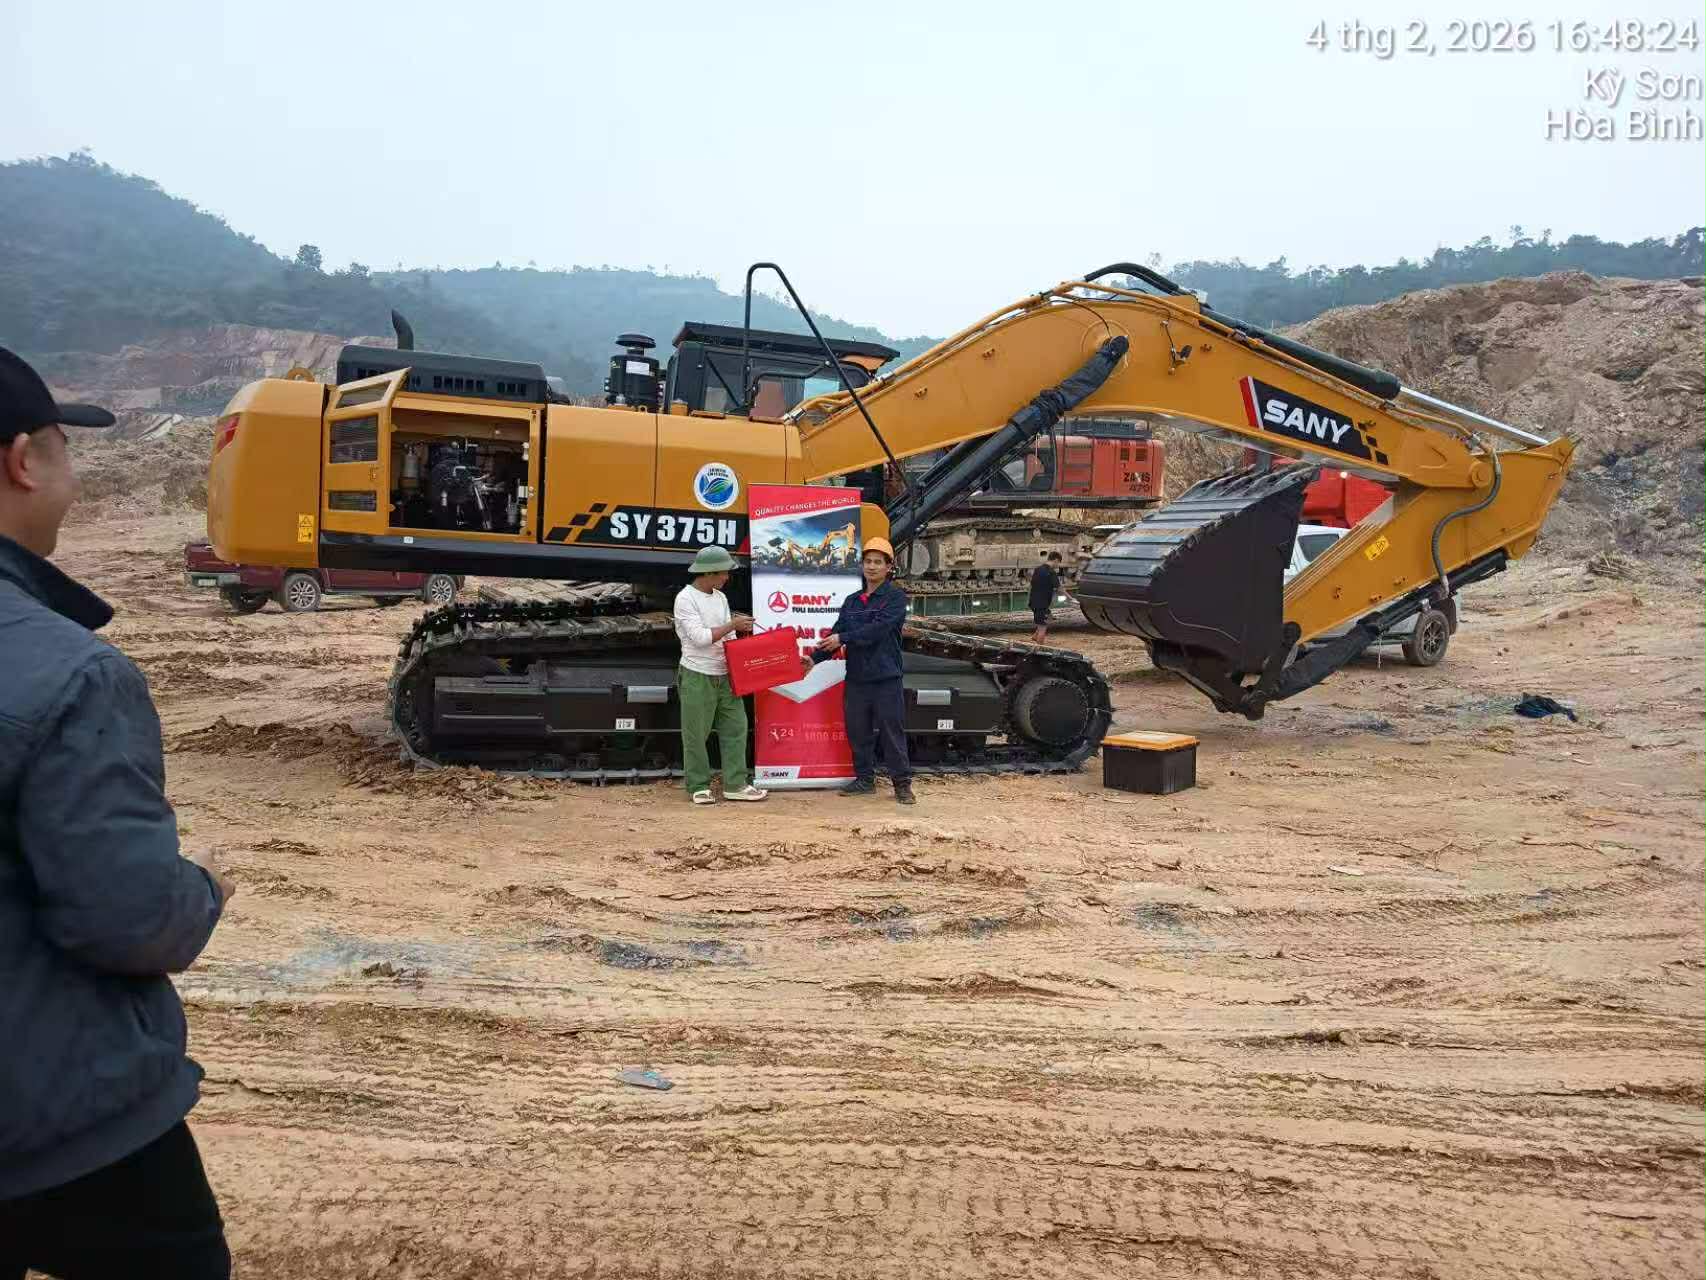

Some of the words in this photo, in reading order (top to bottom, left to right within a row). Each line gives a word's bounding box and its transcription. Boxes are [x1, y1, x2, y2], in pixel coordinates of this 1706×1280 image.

[1264, 399, 1351, 444] SANY
[755, 505, 784, 516] QUALITY
[785, 502, 817, 512] CHANGES
[818, 499, 830, 507] THE
[832, 497, 856, 506] WORLD
[610, 512, 651, 540] SY
[656, 515, 737, 545] 375H
[792, 595, 832, 606] SANY
